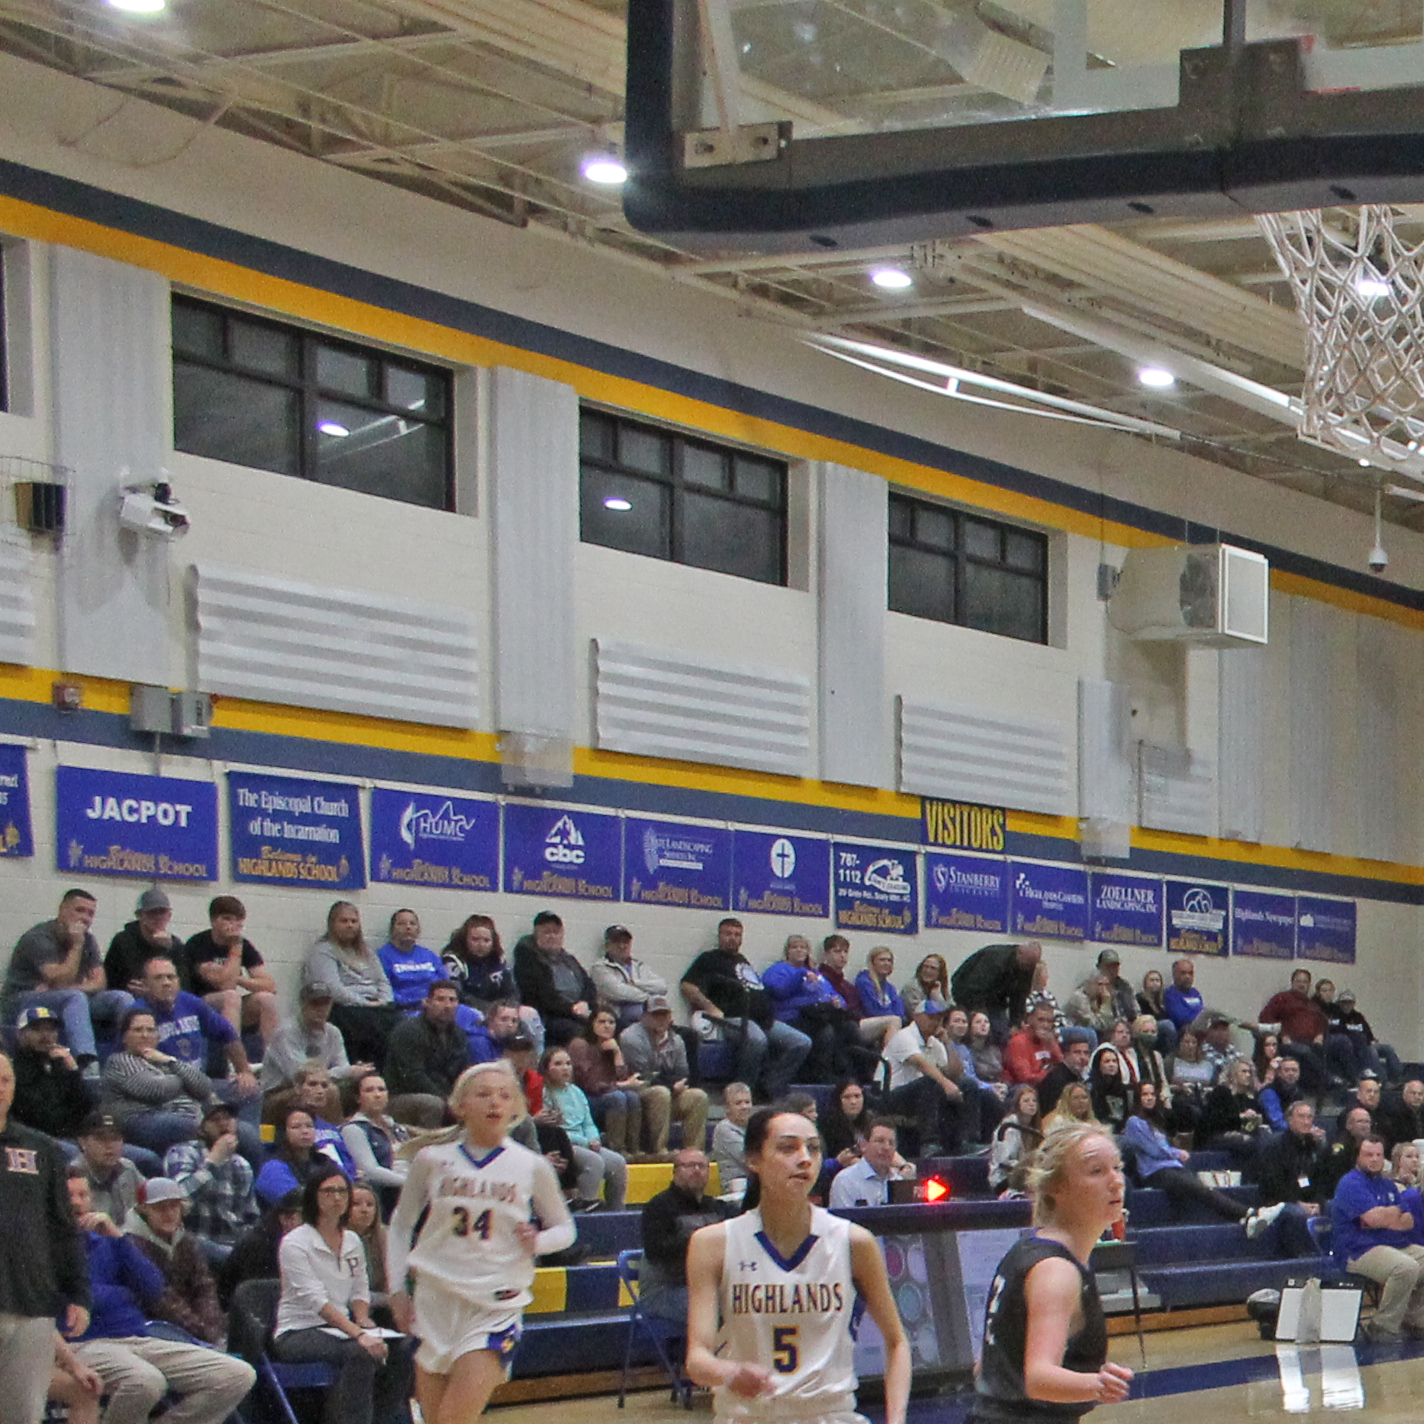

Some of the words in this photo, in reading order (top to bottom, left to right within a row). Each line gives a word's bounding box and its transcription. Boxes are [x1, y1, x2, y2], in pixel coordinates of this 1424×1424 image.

[86, 796, 192, 827] JACPOT
[237, 788, 258, 807] The
[261, 791, 311, 816] Episcopal
[313, 796, 349, 817] Church
[250, 817, 261, 835] of
[263, 819, 281, 837] the
[284, 821, 339, 843] Incarnation
[420, 818, 465, 837] HUMC
[926, 800, 1004, 850] VISITORS
[545, 847, 585, 864] cbc
[238, 858, 297, 878] HIGHLANDS
[299, 863, 339, 881] SCHOOL
[838, 869, 862, 884] 1112
[949, 866, 1000, 890] STANBERRY
[1101, 885, 1155, 903] ZOELLNER
[452, 1205, 494, 1240] 34
[732, 1282, 844, 1315] HIGHLANDS
[773, 1325, 799, 1374] 5
